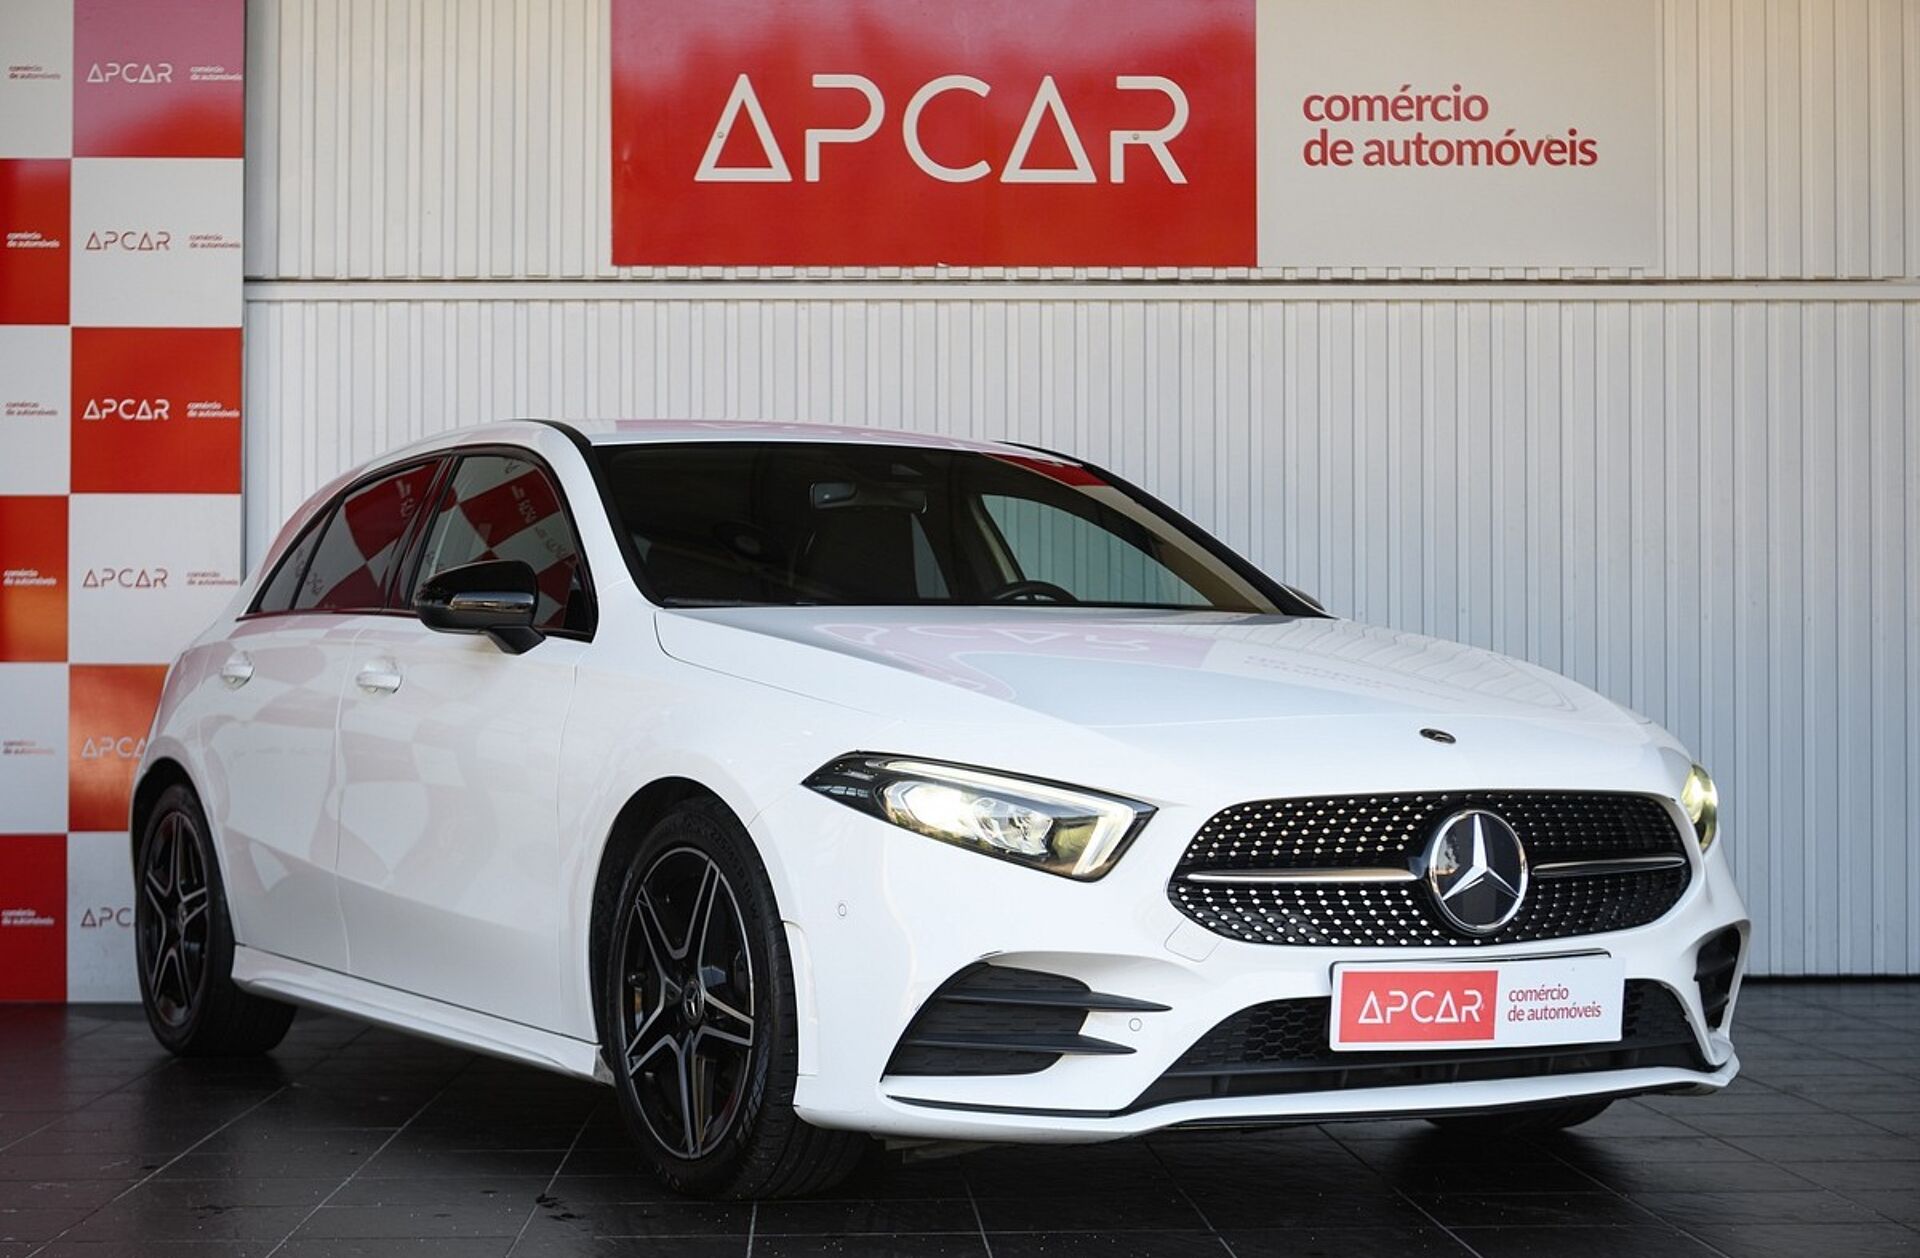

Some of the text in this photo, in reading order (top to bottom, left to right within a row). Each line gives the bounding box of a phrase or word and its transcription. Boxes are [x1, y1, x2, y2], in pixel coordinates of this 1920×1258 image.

[86, 63, 173, 83] APCAR
[1302, 84, 1489, 122] comércio
[692, 73, 1190, 185] APCAR
[1302, 128, 1599, 167] de automóveis
[85, 231, 171, 250] APCAR
[82, 398, 170, 420] APCAR
[83, 568, 168, 588] APCAR
[82, 736, 147, 759] APCA
[1508, 984, 1569, 1002] comércio
[1357, 989, 1484, 1025] APCAR
[1507, 1001, 1602, 1022] de automóveis
